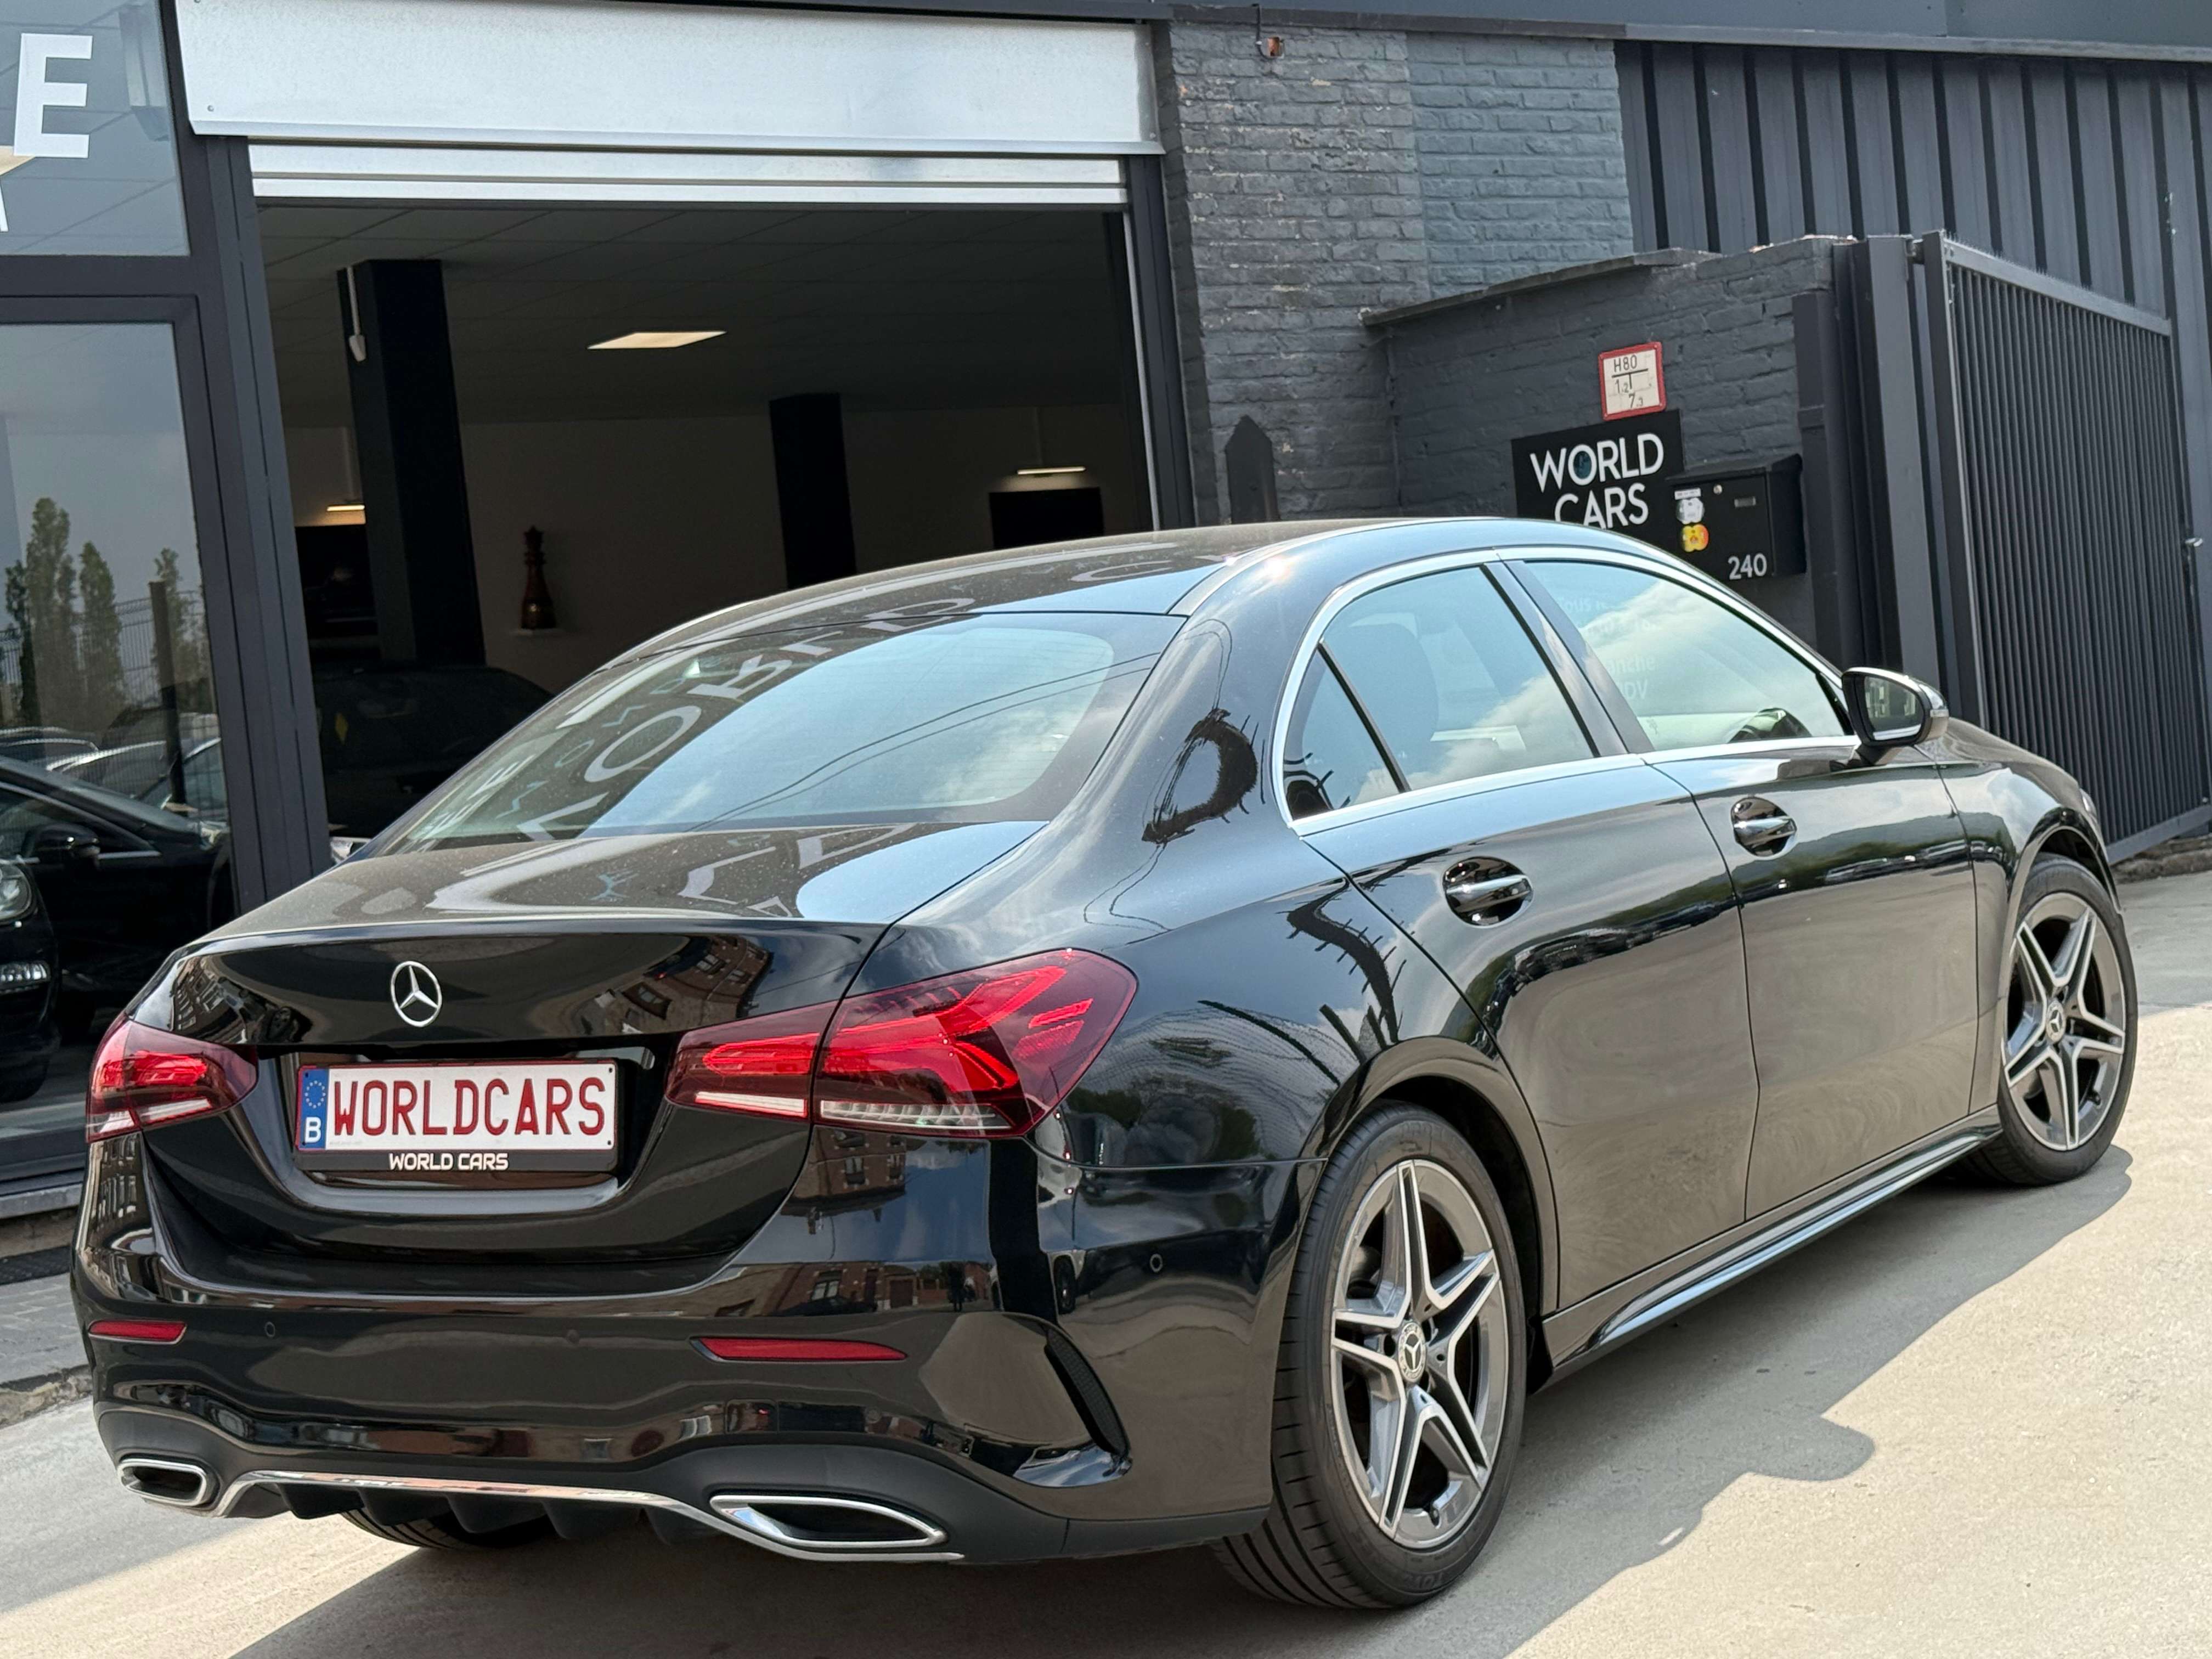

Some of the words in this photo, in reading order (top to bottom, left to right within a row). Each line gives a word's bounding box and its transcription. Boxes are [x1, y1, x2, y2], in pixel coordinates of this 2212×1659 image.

[1613, 354, 1638, 373] H80
[1530, 433, 1664, 493] WORLD
[1554, 482, 1649, 530] CARS
[1728, 552, 1767, 580] 240
[334, 1077, 606, 1136] WORLDCARS
[304, 1116, 321, 1143] B
[389, 1153, 454, 1171] WORLD
[458, 1153, 509, 1171] CARS
